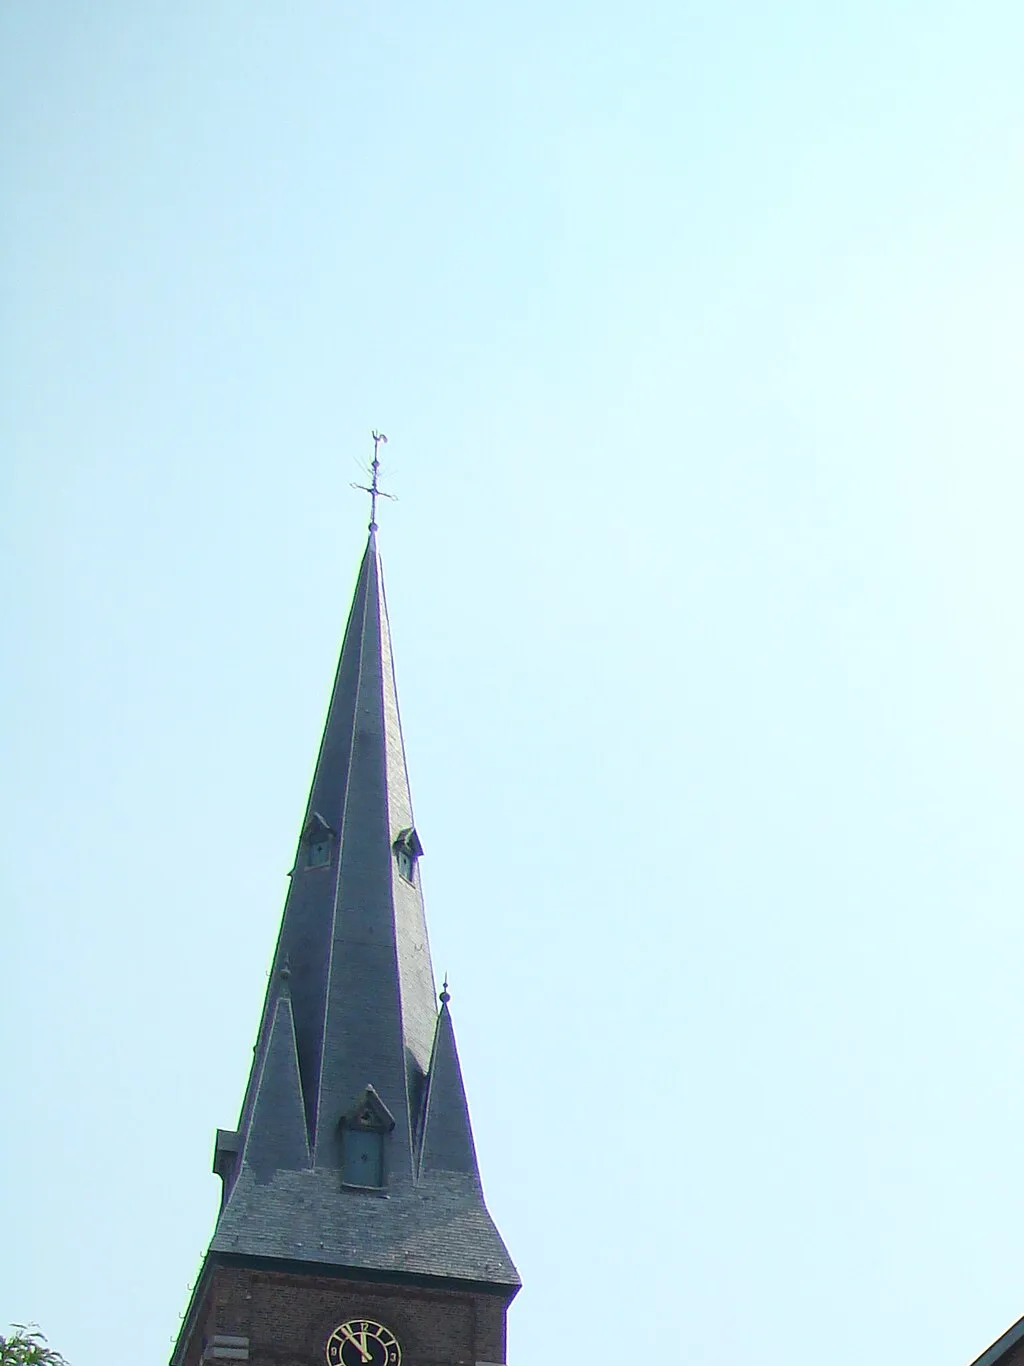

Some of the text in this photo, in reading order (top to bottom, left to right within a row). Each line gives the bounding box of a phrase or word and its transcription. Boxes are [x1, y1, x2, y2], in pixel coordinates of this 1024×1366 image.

[361, 1323, 369, 1333] 12
[331, 1347, 337, 1356] 9
[390, 1353, 397, 1362] 3
